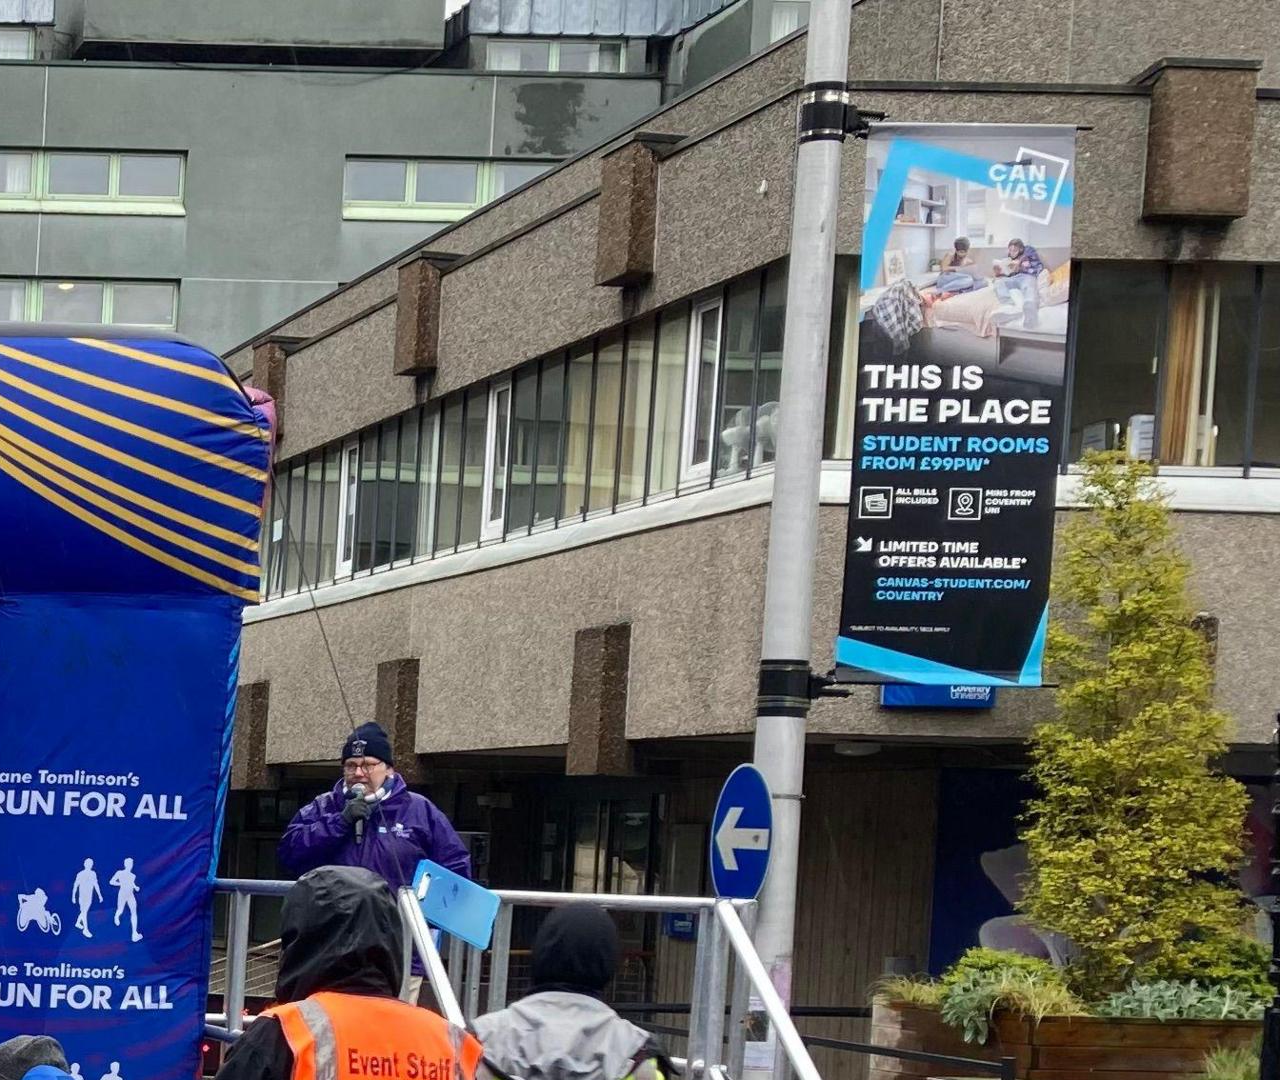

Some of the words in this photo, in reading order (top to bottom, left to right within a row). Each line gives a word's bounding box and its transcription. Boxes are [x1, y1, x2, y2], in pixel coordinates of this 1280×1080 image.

[988, 163, 1046, 182] CAN
[996, 182, 1048, 200] VAS
[863, 364, 942, 390] THIS
[951, 365, 984, 391] IS
[862, 397, 930, 423] THE
[938, 398, 1052, 425] PLACE
[862, 435, 962, 452] STUDENT
[967, 437, 1050, 454] ROOMS
[861, 456, 915, 470] FROM
[895, 497, 940, 505] INCLUDED
[896, 488, 912, 496] ALL
[913, 488, 937, 496] BILLS
[985, 489, 1009, 497] MINS
[1010, 489, 1036, 498] FROM
[985, 498, 1032, 506] COVENTRY
[879, 541, 939, 553] LIMITED
[942, 541, 979, 554] TIME
[878, 556, 937, 568] OFFERS
[877, 577, 1031, 590] CANVAS-STUDENT.COM/
[875, 591, 944, 601] COVENTRY
[38, 769, 140, 787] Tomlinson's
[63, 791, 126, 818] FOR
[133, 793, 188, 820] ALL
[23, 962, 125, 980] Tomlinson's
[49, 983, 112, 1010] FOR
[119, 984, 173, 1010] ALL
[348, 1047, 400, 1078] Event
